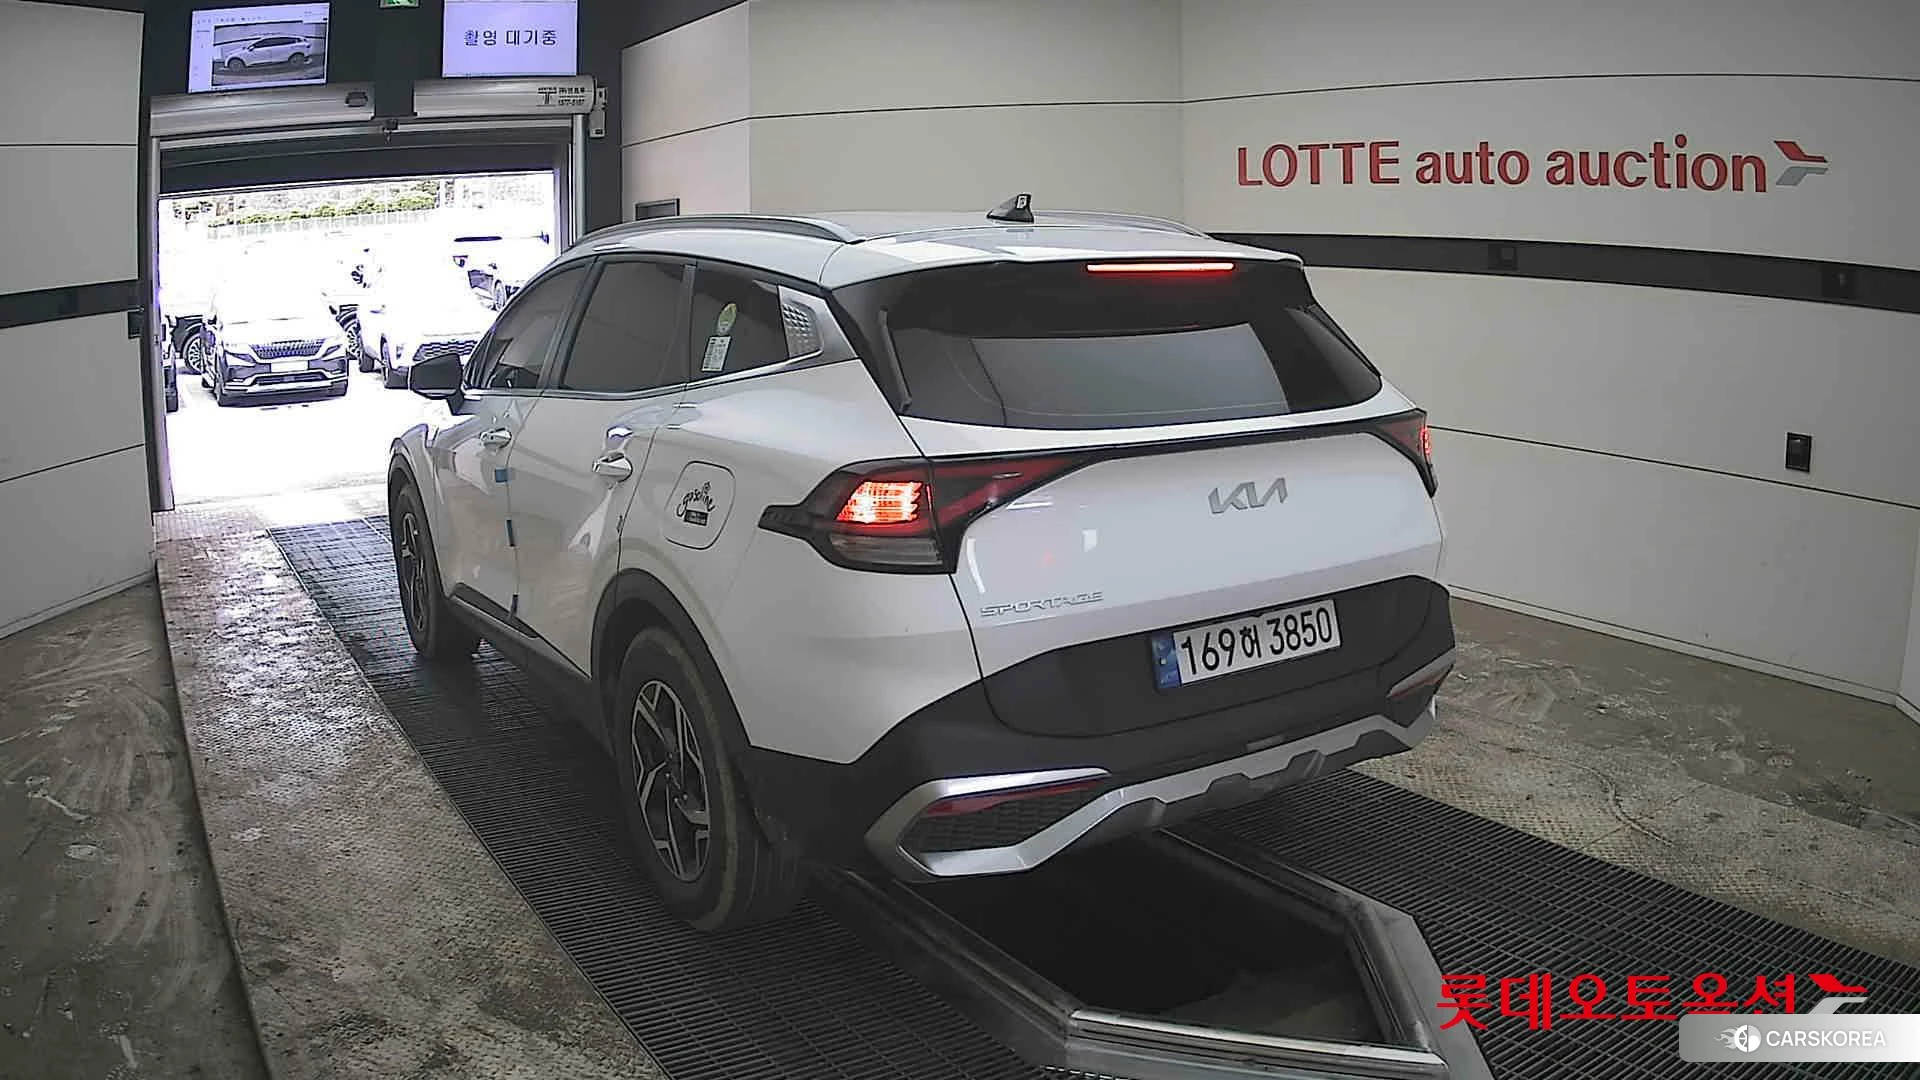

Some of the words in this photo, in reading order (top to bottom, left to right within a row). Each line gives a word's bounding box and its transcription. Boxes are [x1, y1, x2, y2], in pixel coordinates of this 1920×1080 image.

[505, 29, 557, 46] 대기중
[1237, 140, 1400, 187] LOTTE
[1415, 142, 1531, 186] auto
[1545, 134, 1767, 193] auction
[1208, 477, 1288, 515] KIA
[980, 591, 1105, 617] SPORTAGE
[1181, 624, 1262, 675] 169허
[1266, 607, 1333, 655] 3850
